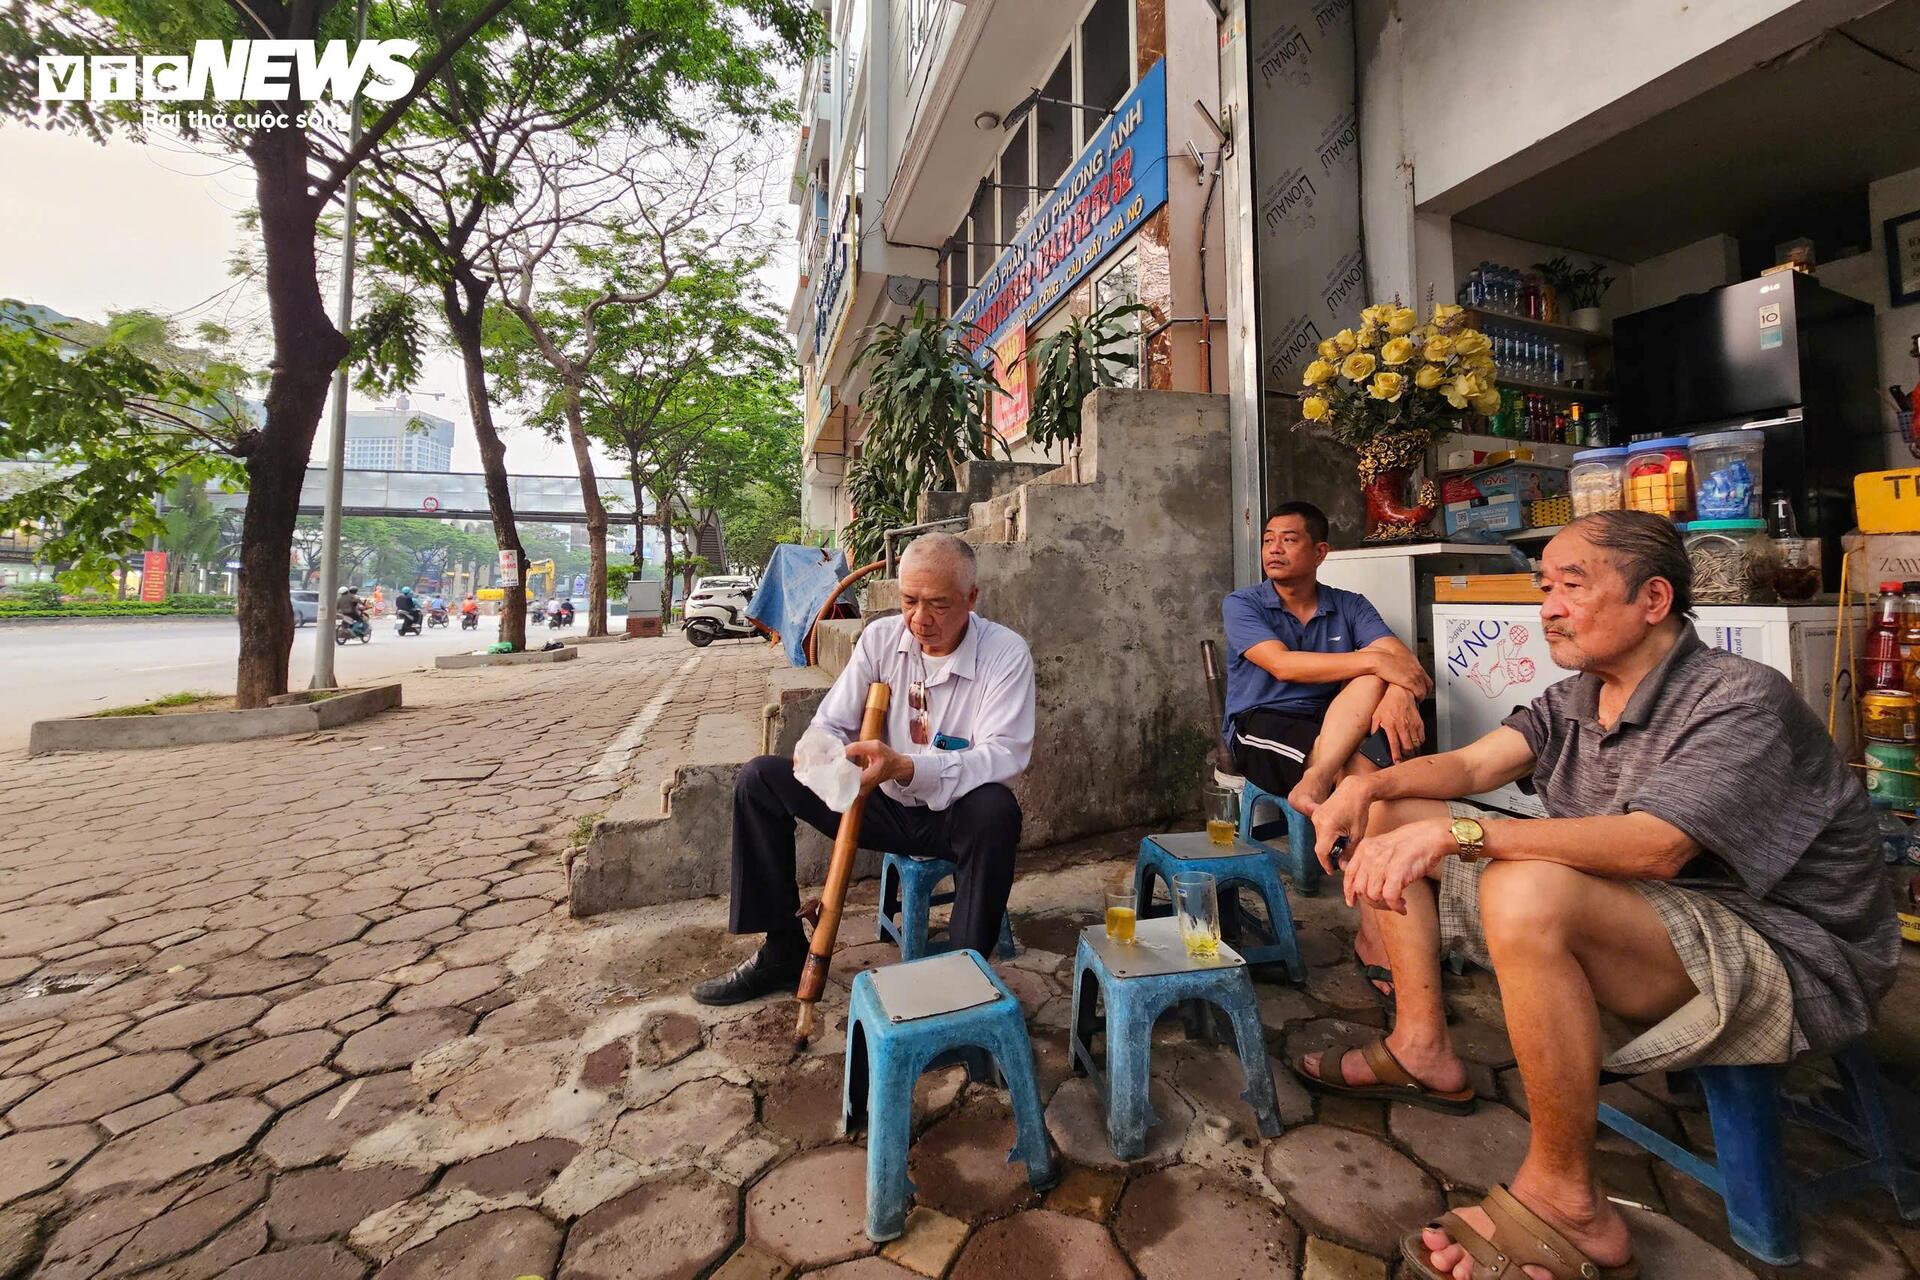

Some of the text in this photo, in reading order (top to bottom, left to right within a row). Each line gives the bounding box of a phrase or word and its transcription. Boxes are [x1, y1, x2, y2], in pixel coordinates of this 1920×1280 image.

[1261, 32, 1312, 80] LIONALU
[1112, 146, 1134, 205] 52
[1266, 174, 1317, 229] LIONALU
[976, 289, 986, 312] TY
[1027, 212, 1051, 250] TAXI
[1108, 99, 1142, 159] ANH
[1110, 213, 1125, 240] HÀ
[1761, 312, 1778, 324] 10
[1271, 321, 1322, 379] LIONALU
